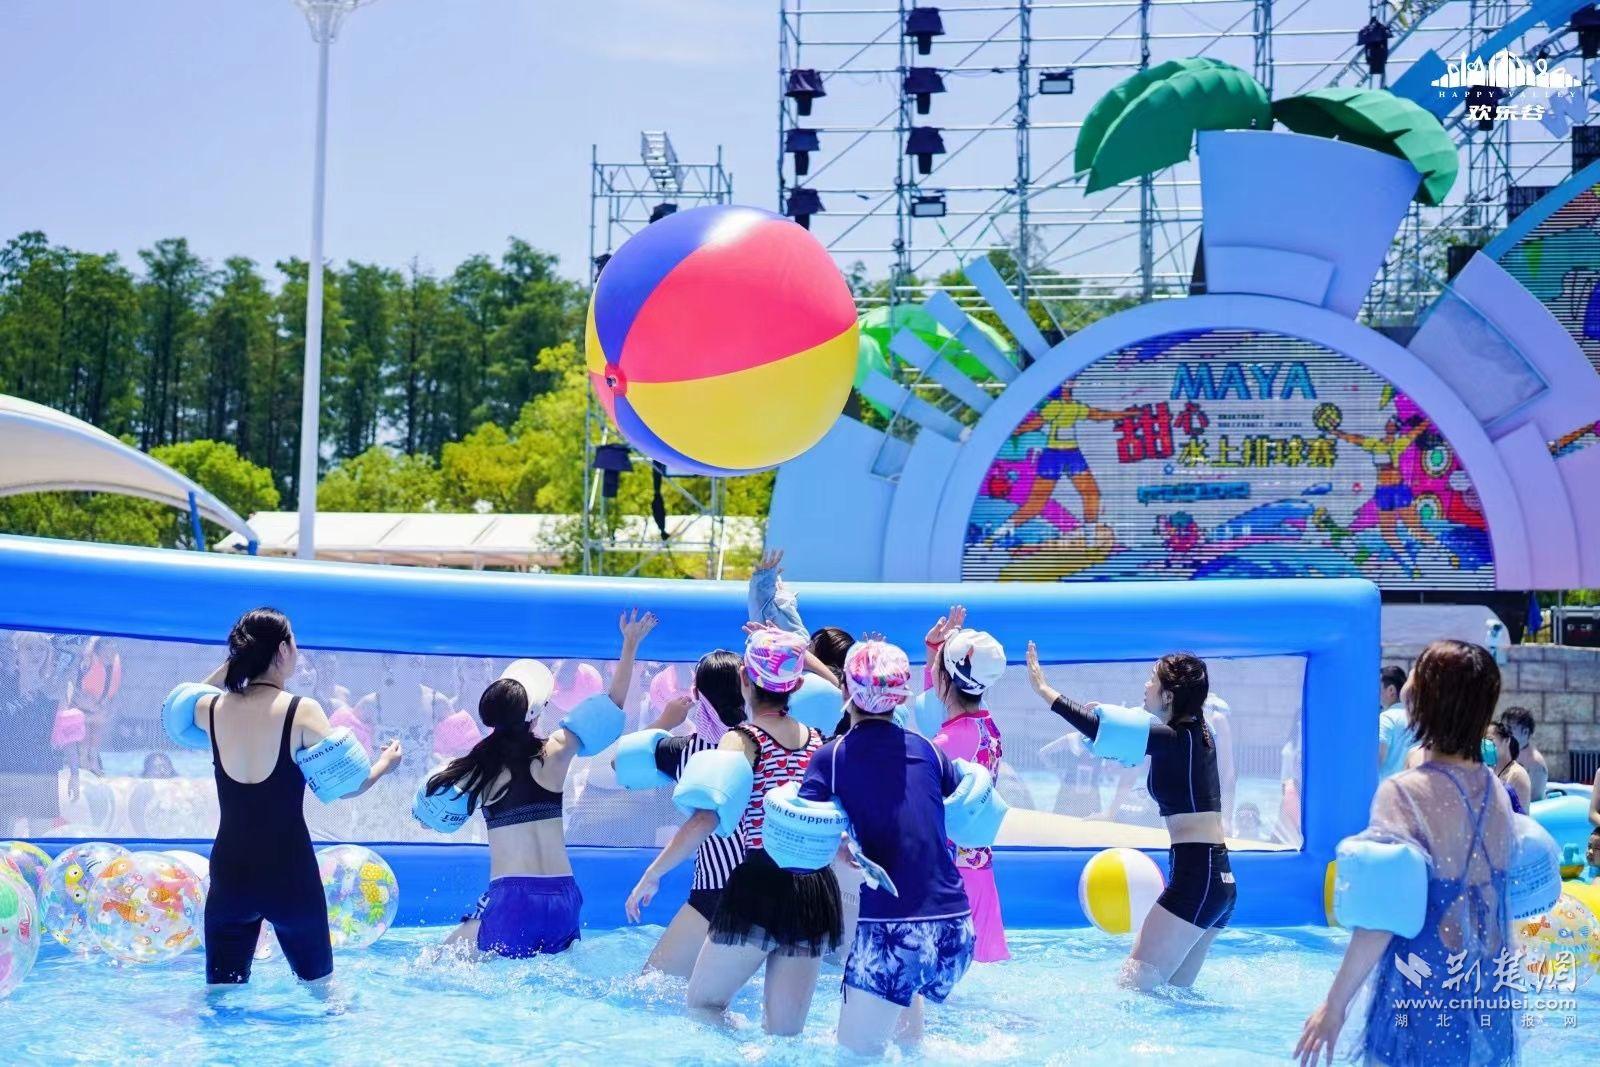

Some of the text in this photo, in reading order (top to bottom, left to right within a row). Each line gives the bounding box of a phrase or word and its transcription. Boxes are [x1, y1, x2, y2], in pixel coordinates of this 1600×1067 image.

[1170, 361, 1318, 400] MAYA
[1113, 401, 1209, 463] 甜心
[1176, 434, 1338, 468] 水上排球赛
[784, 809, 796, 819] to
[800, 815, 833, 825] upper
